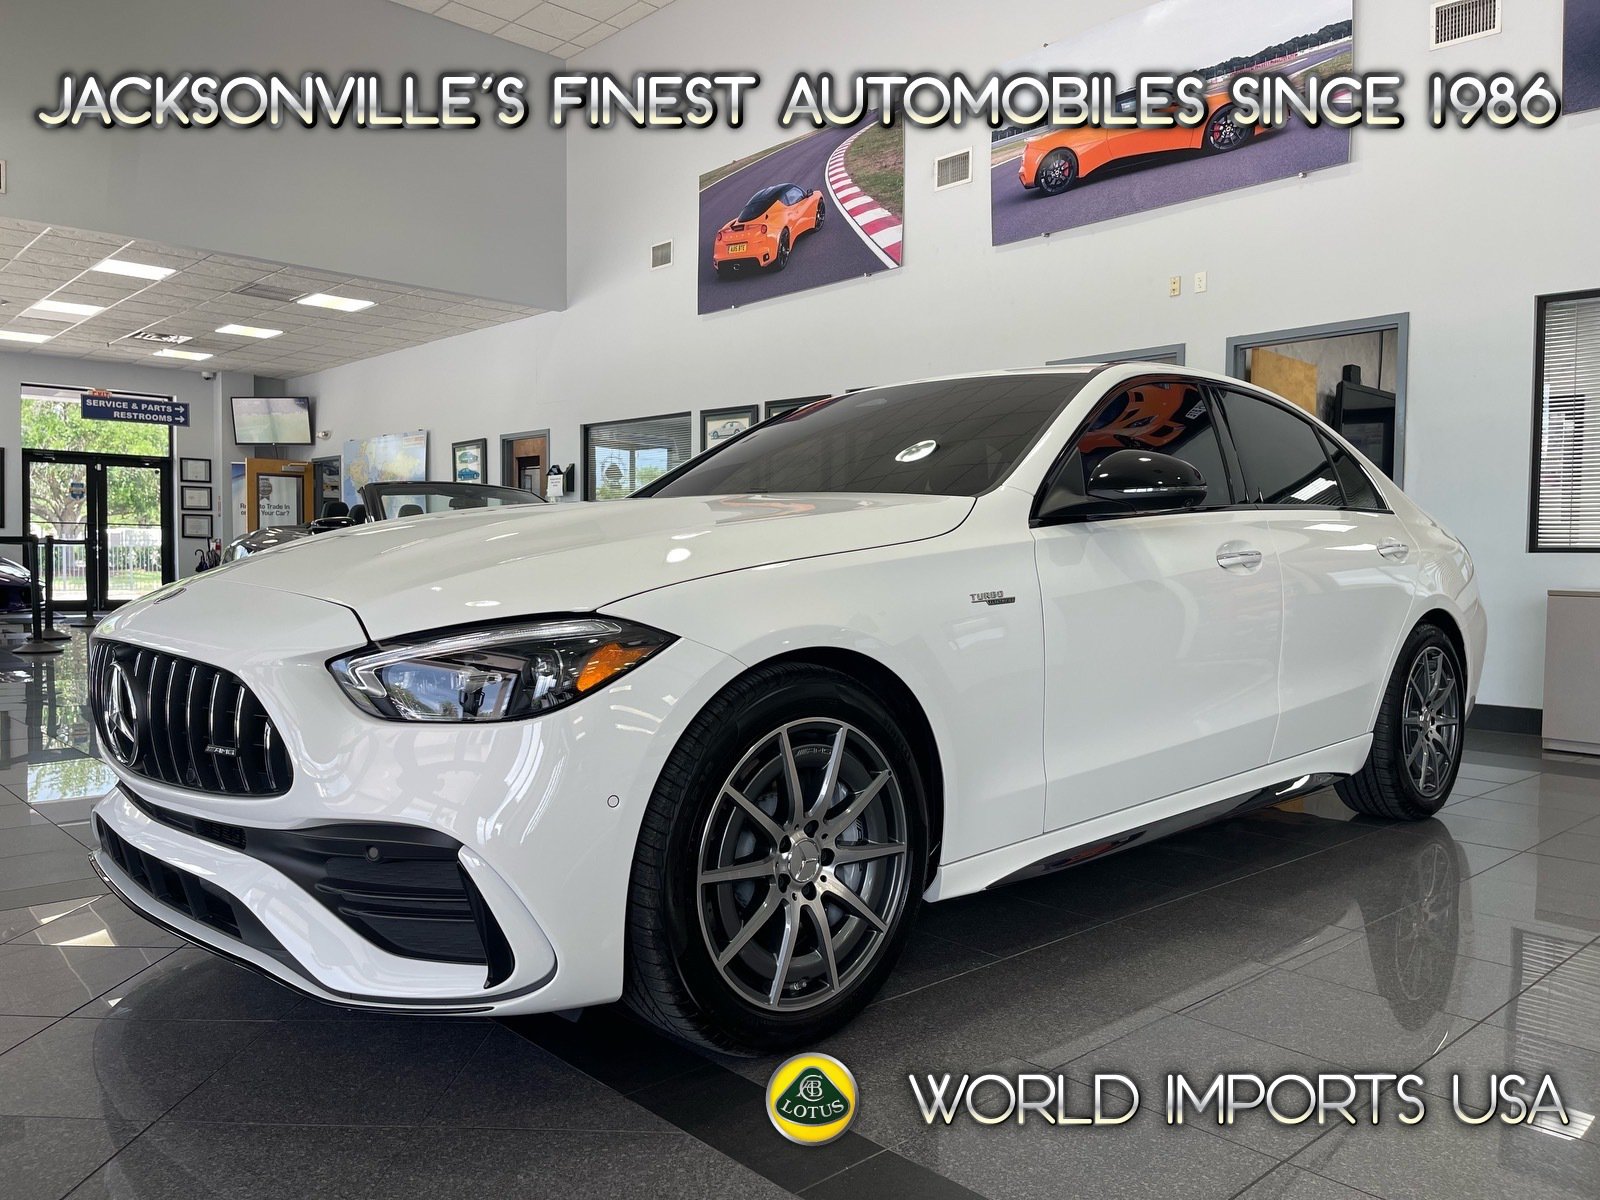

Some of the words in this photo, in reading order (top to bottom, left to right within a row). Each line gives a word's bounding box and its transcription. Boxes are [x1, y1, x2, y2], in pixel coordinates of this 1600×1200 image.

[86, 398, 128, 408] SERVICE
[131, 402, 138, 410] &
[141, 403, 172, 412] PARTS
[113, 411, 172, 421] RESTROOMS
[969, 591, 1003, 600] TURBO
